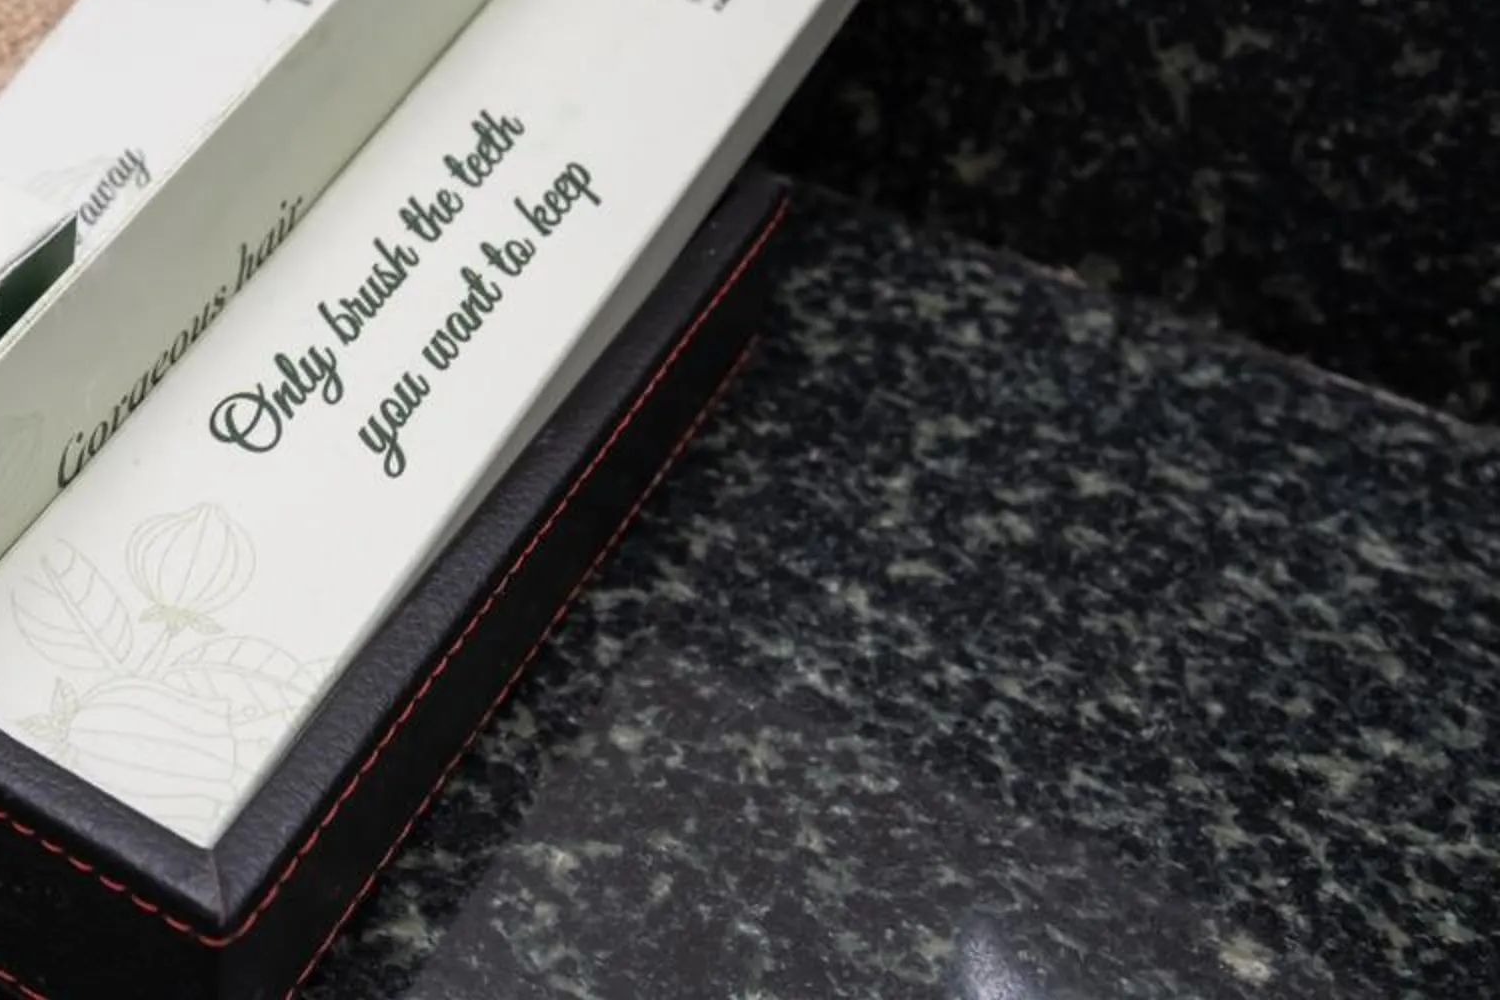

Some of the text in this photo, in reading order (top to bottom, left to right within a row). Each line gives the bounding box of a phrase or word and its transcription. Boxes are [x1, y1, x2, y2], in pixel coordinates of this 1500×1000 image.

[79, 147, 151, 226] away
[209, 109, 525, 454] Only brush the teeth
[233, 196, 303, 292] hair
[357, 161, 602, 478] you want to keep
